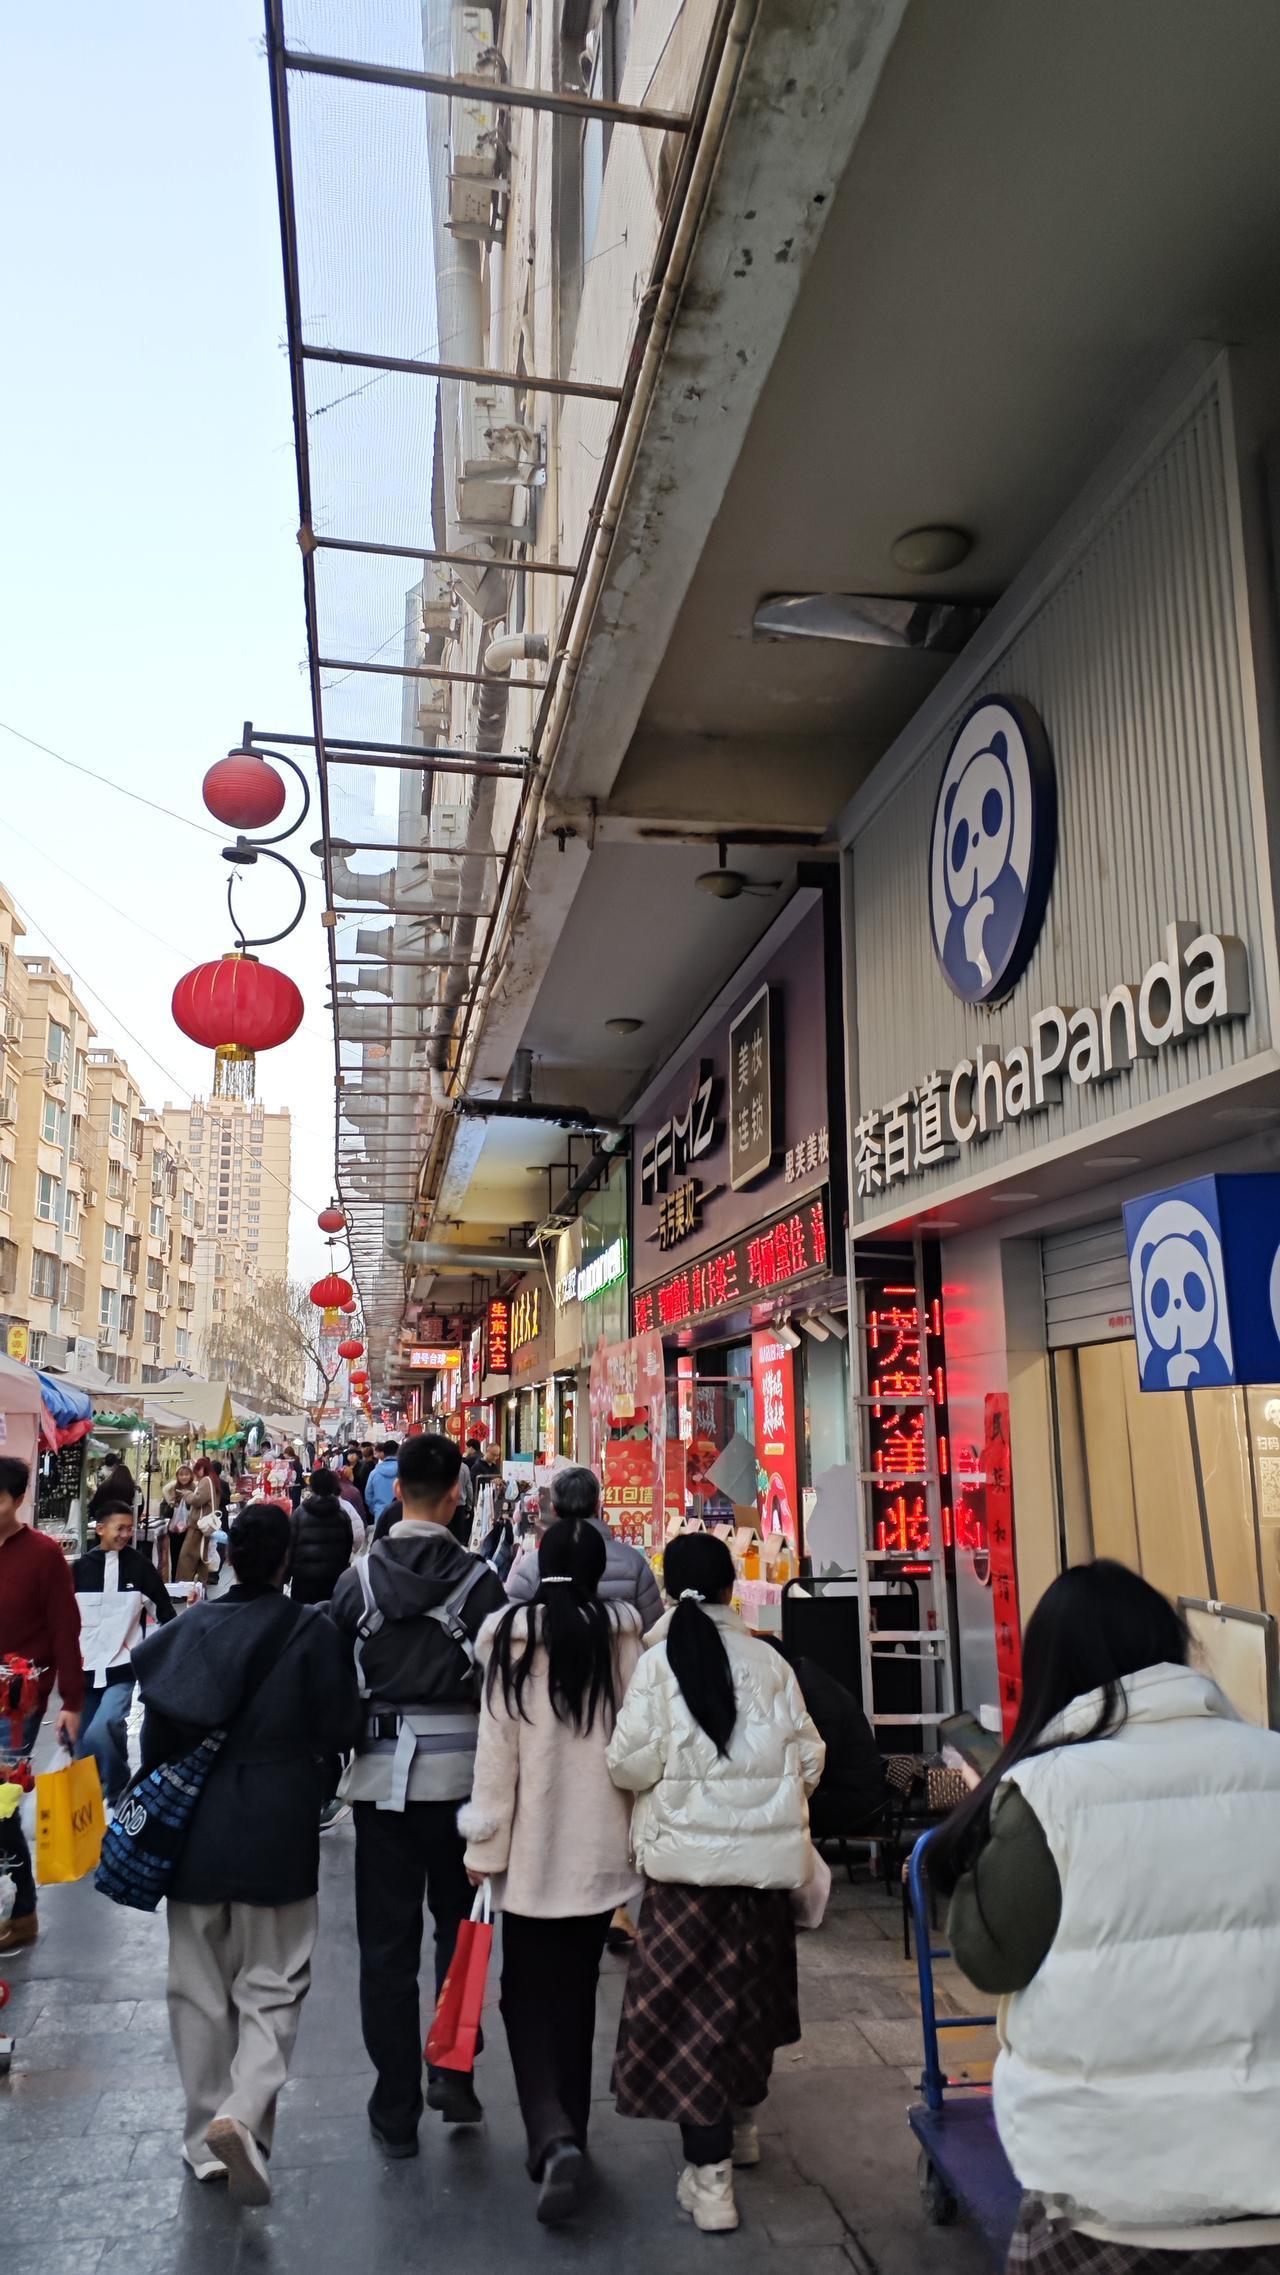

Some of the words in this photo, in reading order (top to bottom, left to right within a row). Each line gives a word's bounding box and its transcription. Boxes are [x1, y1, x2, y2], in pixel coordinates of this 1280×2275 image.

[737, 1027, 763, 1094] 美妆
[855, 1071, 950, 1197] 茶百道
[948, 921, 1234, 1142] ChaPanda
[641, 1074, 716, 1203] FFMZ
[737, 1096, 763, 1154] 连锁
[784, 1127, 829, 1184] 思芙美妆
[747, 1214, 808, 1288] 玛丽黛佳
[412, 1352, 447, 1366] 壹号台球
[489, 1302, 508, 1369] 生煎大王
[72, 1800, 92, 1833] KKV
